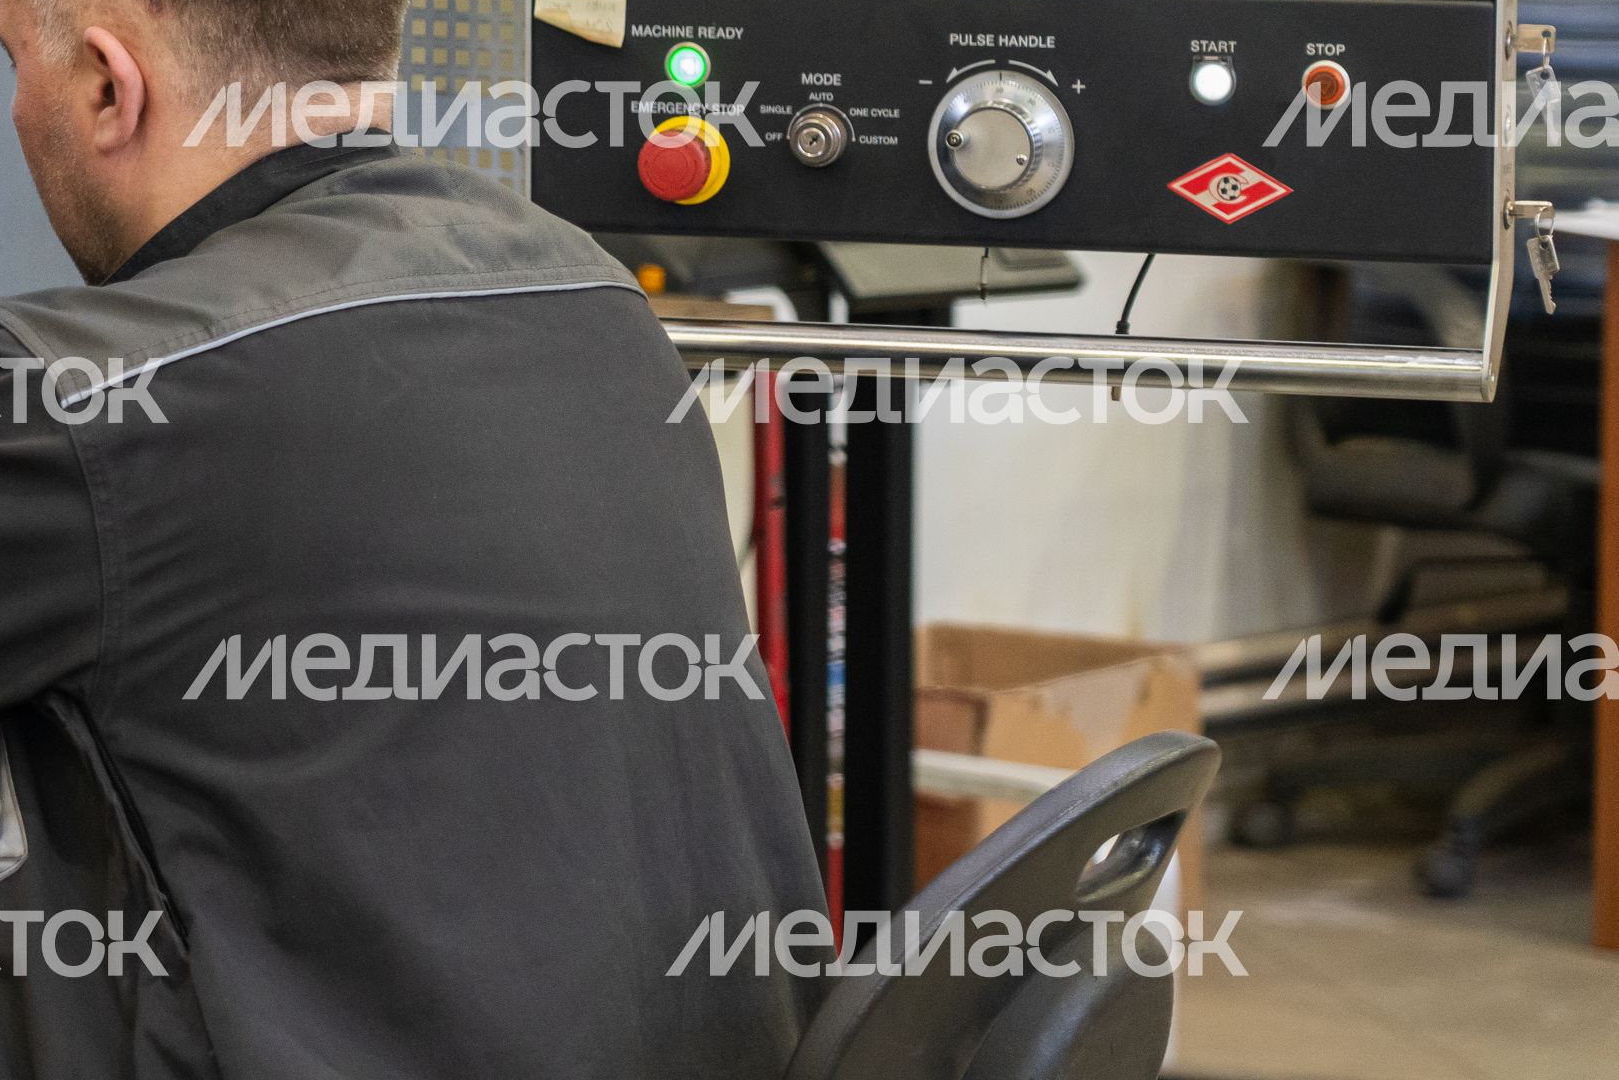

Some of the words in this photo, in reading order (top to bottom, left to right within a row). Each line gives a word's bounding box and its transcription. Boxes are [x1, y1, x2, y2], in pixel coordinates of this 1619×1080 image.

[631, 24, 694, 38] MACHINE
[698, 26, 744, 39] READY
[949, 33, 995, 47] PULSE
[999, 35, 1055, 48] HANDLE
[1190, 40, 1237, 53] START
[1306, 43, 1346, 55] STOP
[801, 72, 842, 86] MODE
[809, 92, 834, 101] AUTO
[631, 100, 708, 115] EMERGENCY
[712, 103, 745, 117] STOP
[759, 104, 793, 115] SINGLE
[849, 107, 868, 116] ONE
[870, 108, 900, 118] CYCLE
[765, 132, 783, 141] OFF
[859, 135, 898, 145] CUSTOM
